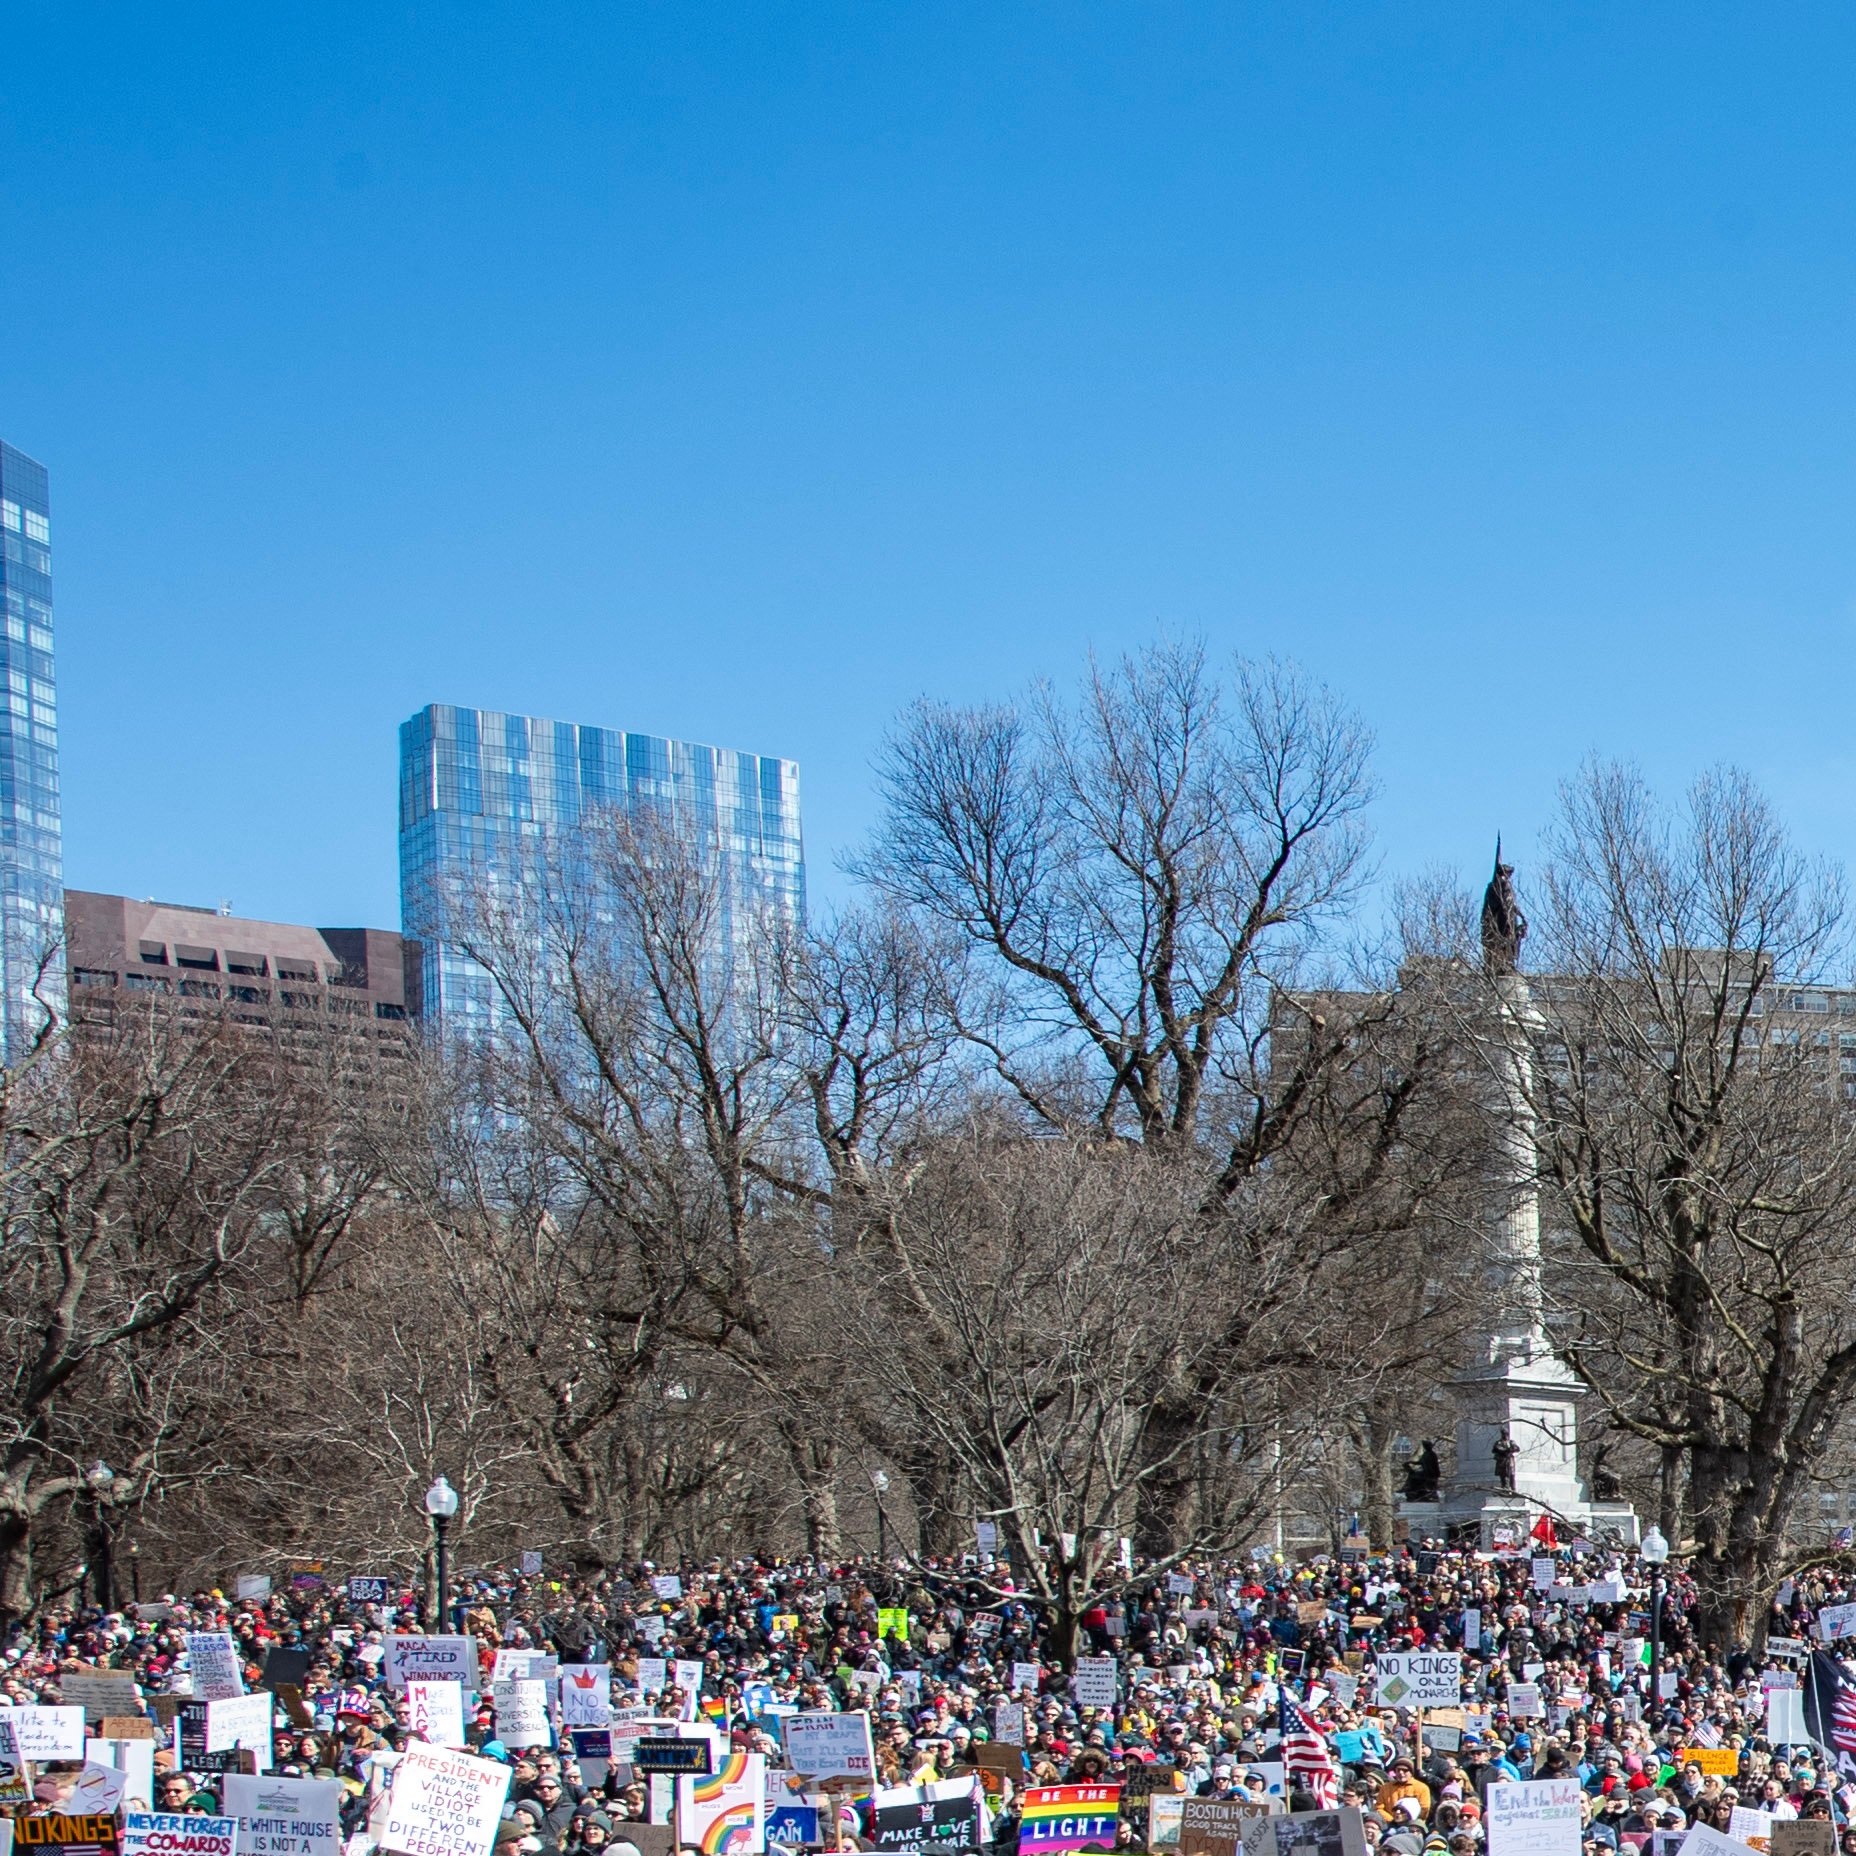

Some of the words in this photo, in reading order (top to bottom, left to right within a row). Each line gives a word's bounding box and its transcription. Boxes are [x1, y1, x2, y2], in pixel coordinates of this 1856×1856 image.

[1379, 1658, 1399, 1676] NO
[1408, 1657, 1457, 1675] KINGS
[1419, 1677, 1457, 1686] ONLY
[571, 1695, 598, 1706] NO
[568, 1710, 608, 1723] KINGS
[406, 1752, 503, 1788] PRESIDENT
[128, 1813, 182, 1831] NEVER
[183, 1817, 234, 1836] FORGET
[250, 1818, 288, 1834] WHITE
[291, 1821, 332, 1837] HOUSE
[1032, 1816, 1106, 1840] LIGHT
[389, 1820, 488, 1856] DIFFERENT
